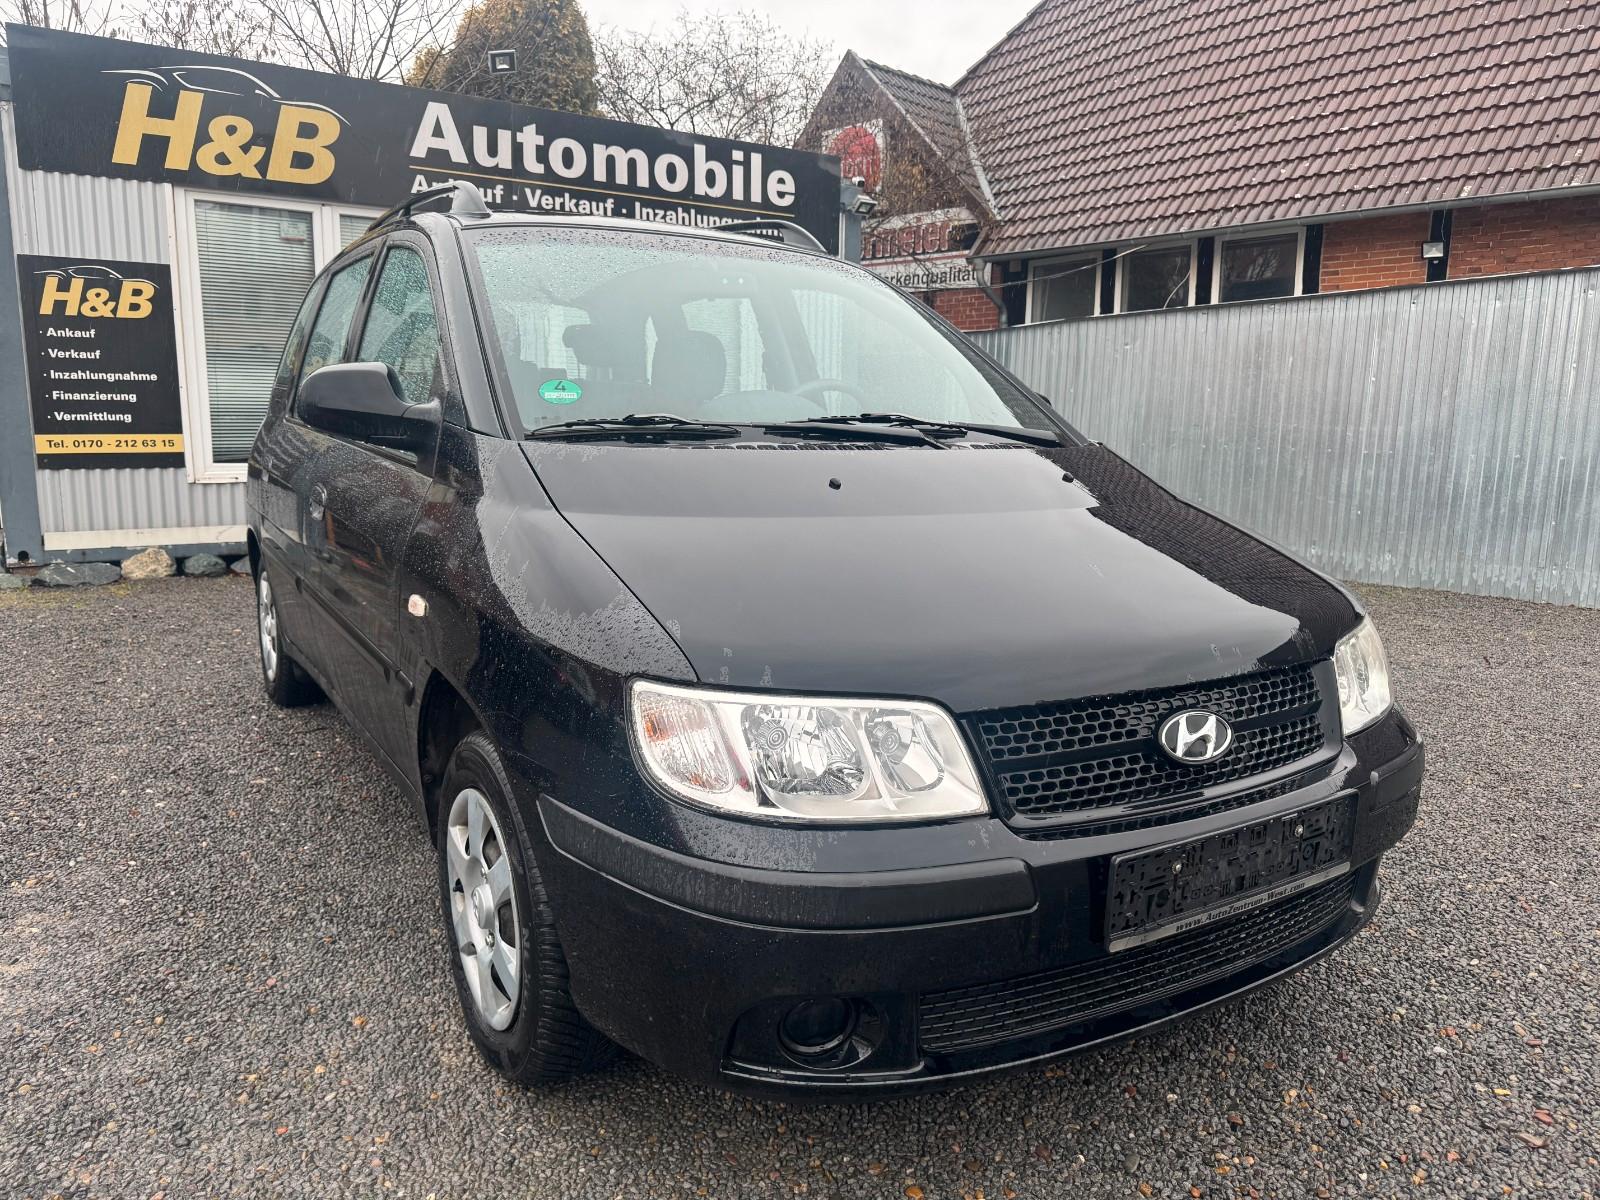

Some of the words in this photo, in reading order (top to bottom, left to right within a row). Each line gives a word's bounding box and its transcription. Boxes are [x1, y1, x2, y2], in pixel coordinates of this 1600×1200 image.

[112, 83, 341, 184] H&B
[409, 101, 797, 207] Automobile
[411, 174, 504, 203] Auf
[524, 187, 615, 217] Verkauf
[39, 276, 155, 319] H&B
[46, 327, 96, 338] Ankauf
[48, 348, 101, 360] Verkauf
[50, 370, 158, 382] Inzahlungnahme
[554, 380, 567, 393] 4
[52, 391, 137, 403] Finanzierung
[54, 412, 132, 423] Vermittlung
[46, 439, 68, 449] Tel.
[72, 439, 103, 448] 0170
[115, 439, 137, 448] 212
[141, 439, 156, 448] 63
[162, 439, 175, 448] 15
